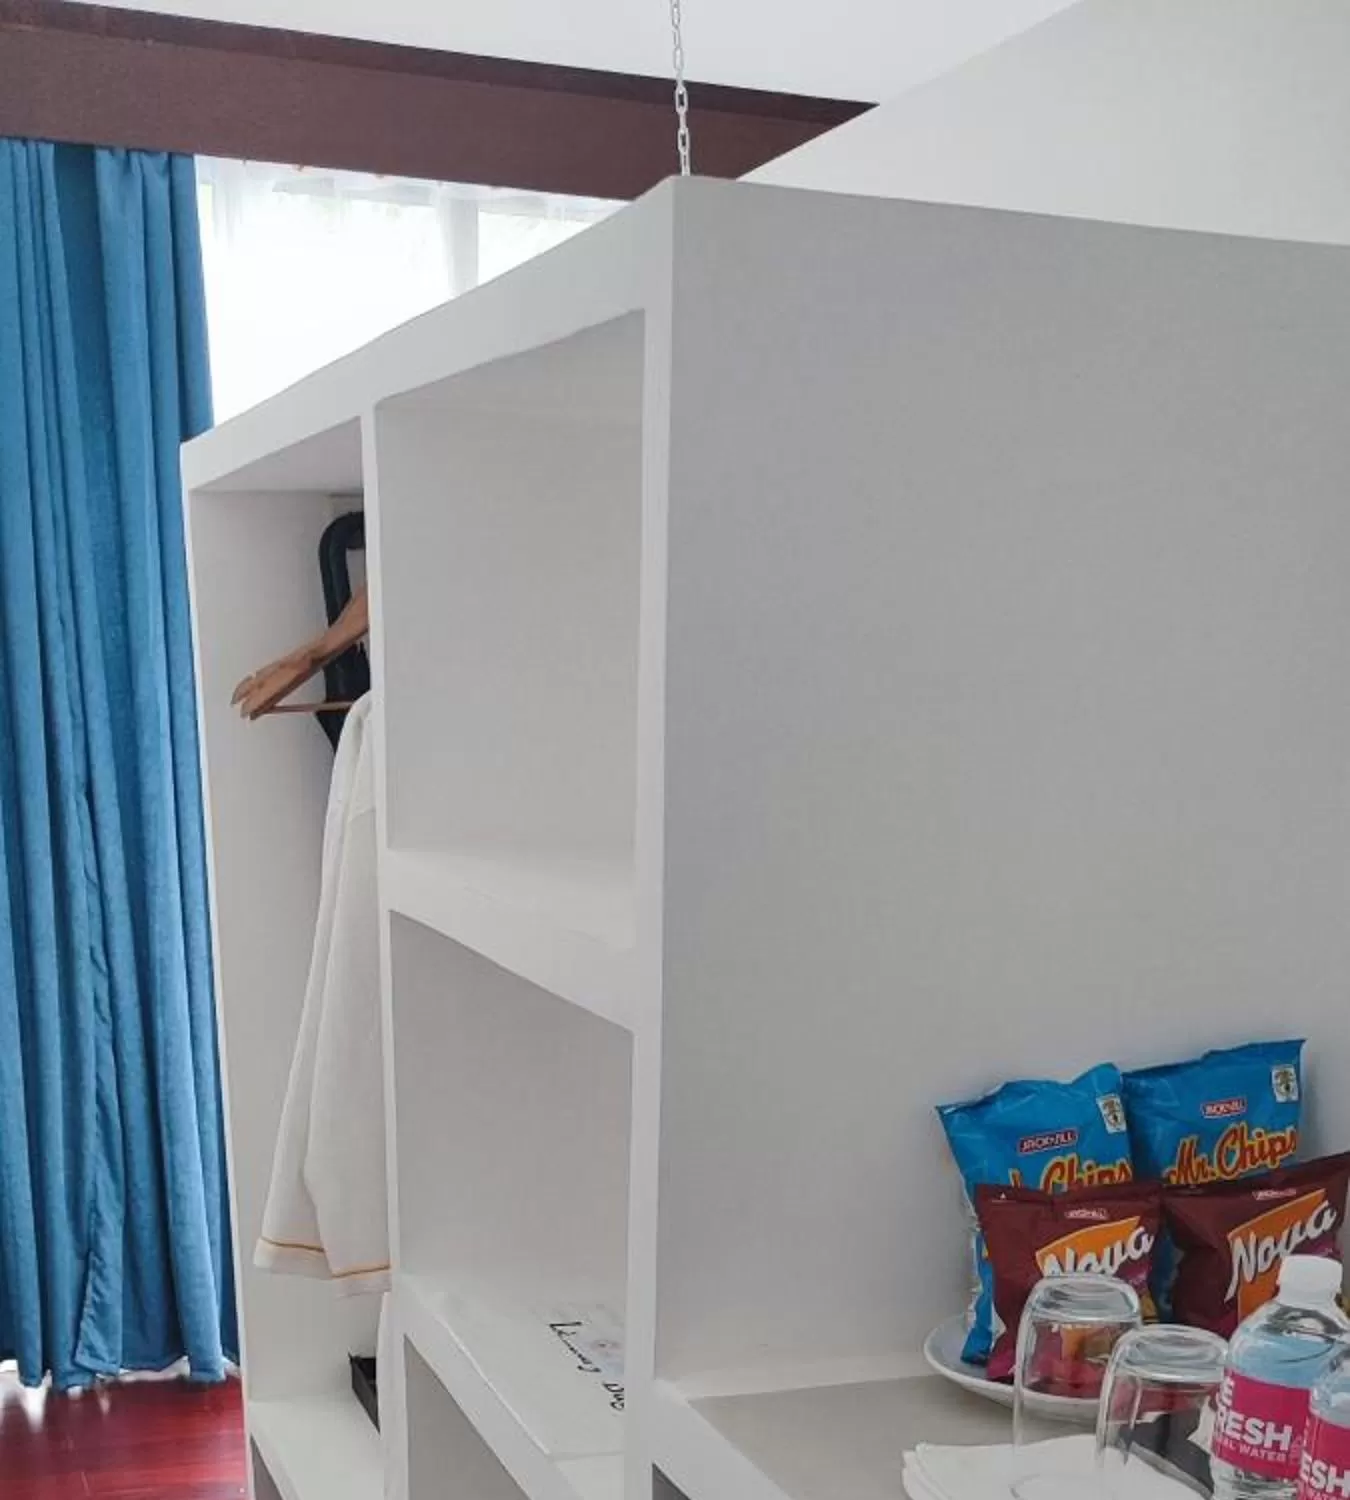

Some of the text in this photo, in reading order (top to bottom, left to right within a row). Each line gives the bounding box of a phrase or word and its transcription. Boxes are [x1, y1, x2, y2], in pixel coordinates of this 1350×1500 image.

[1213, 1120, 1297, 1180] Chips
[1223, 1199, 1338, 1303] Nova
[1213, 1404, 1293, 1451] RESH
[1239, 1442, 1288, 1462] WATER
[1299, 1449, 1350, 1498] ESH
